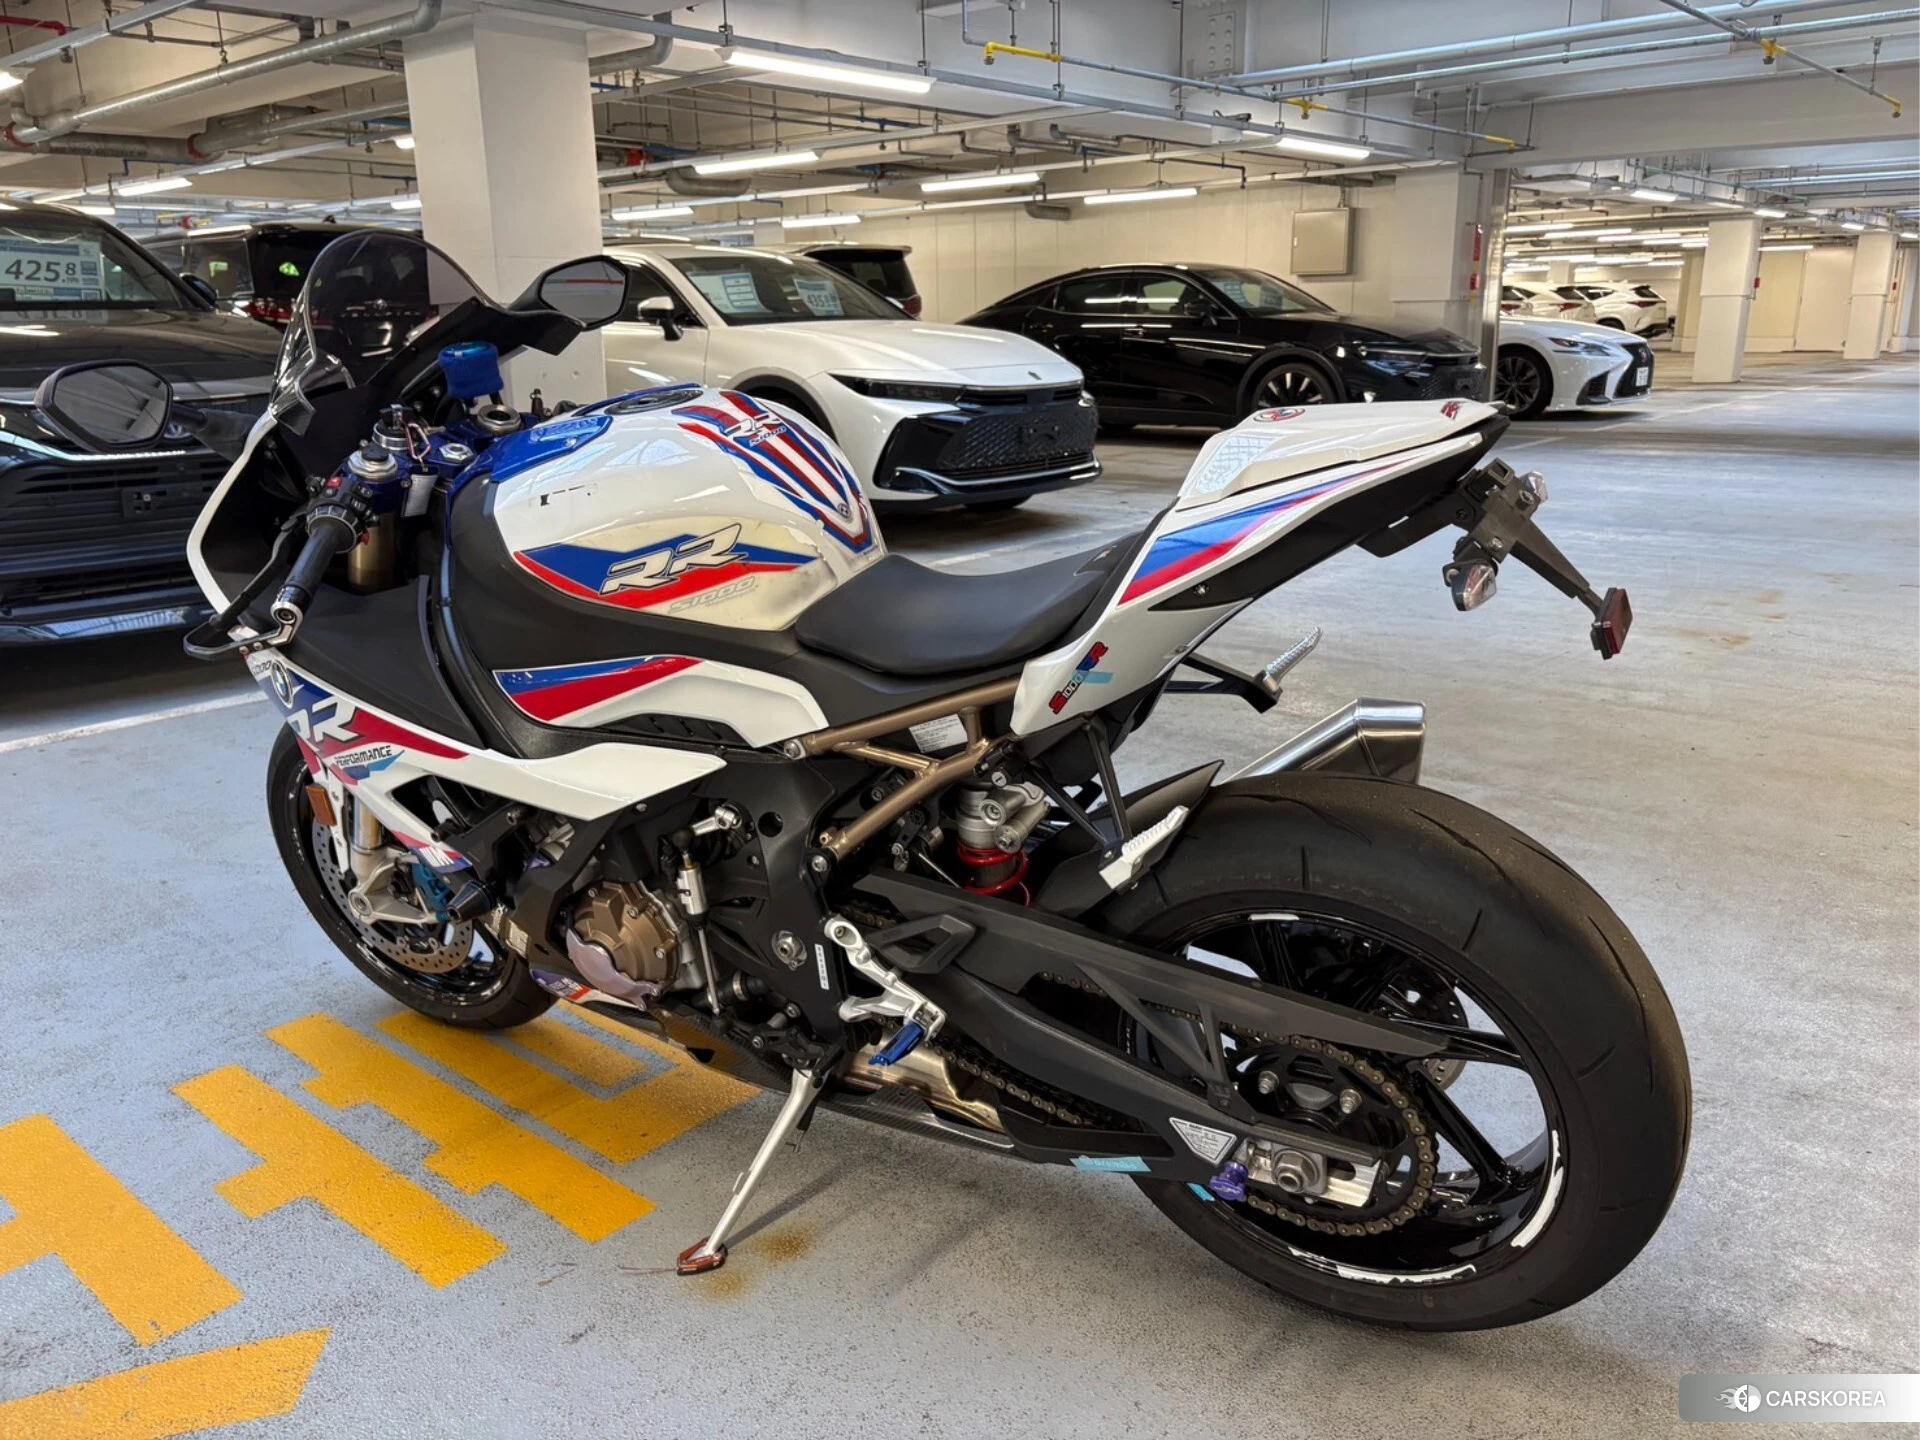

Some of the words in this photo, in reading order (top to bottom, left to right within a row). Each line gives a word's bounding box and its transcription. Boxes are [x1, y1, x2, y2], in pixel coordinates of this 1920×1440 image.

[598, 522, 749, 596] RR
[668, 575, 756, 615] S1000
[336, 745, 393, 766] PERFORMANCE
